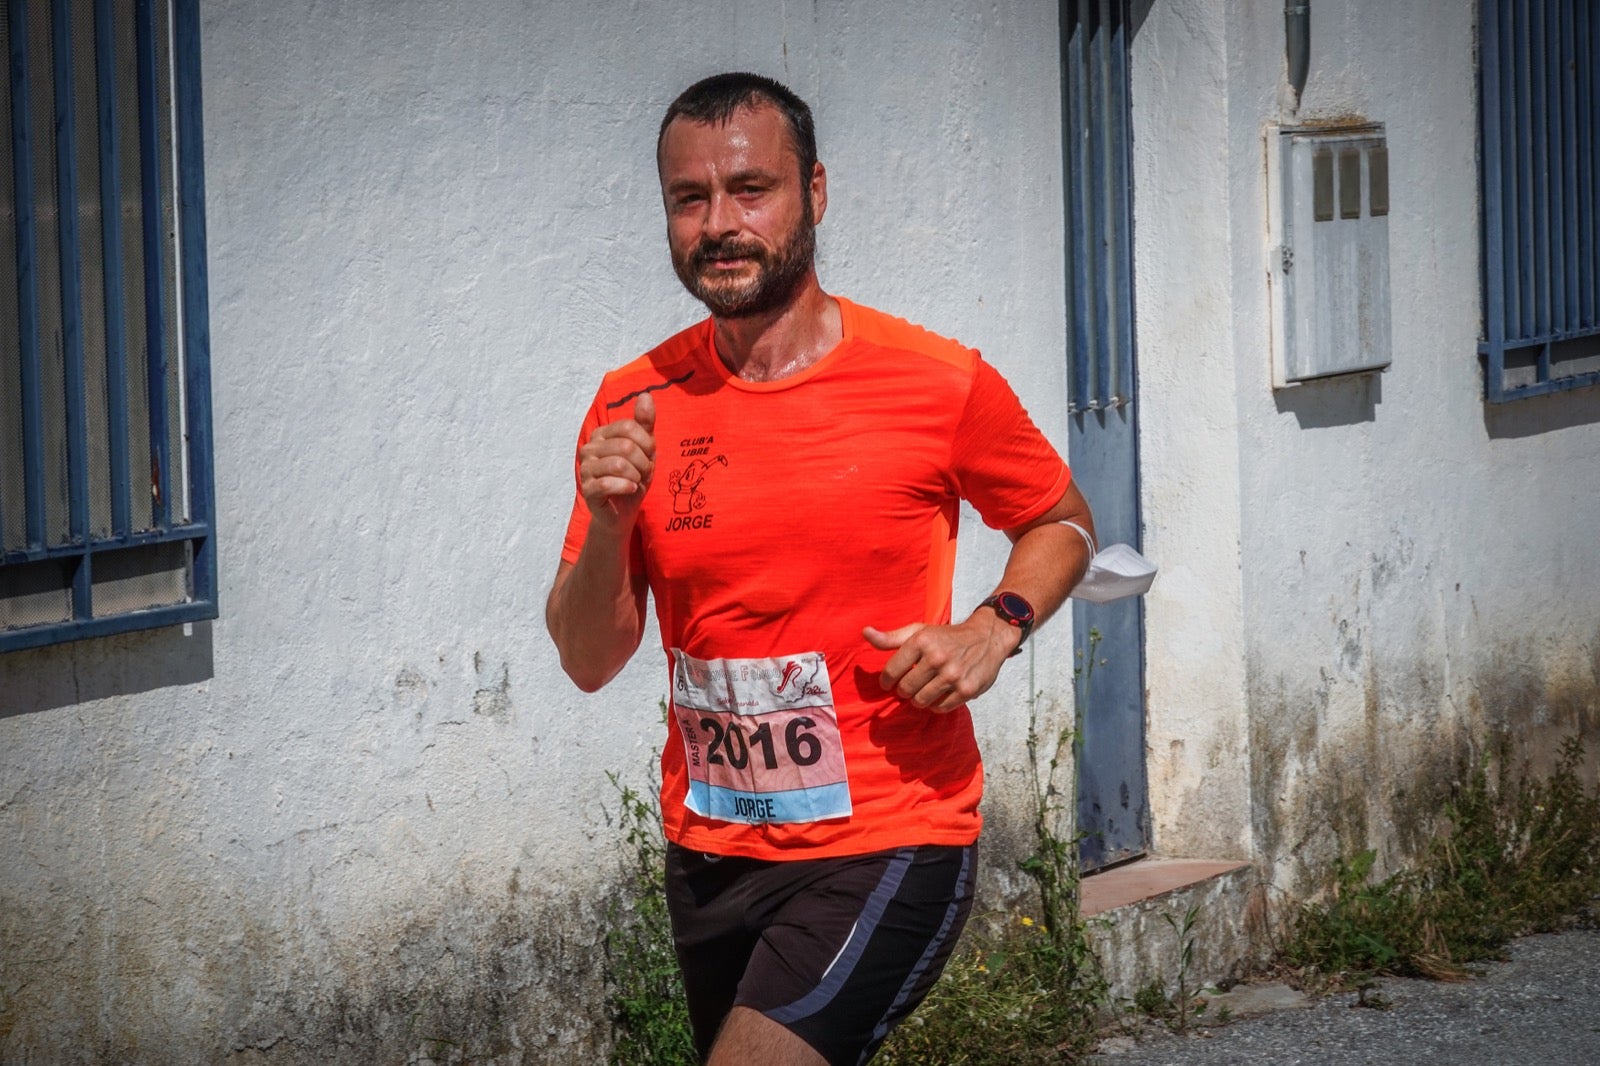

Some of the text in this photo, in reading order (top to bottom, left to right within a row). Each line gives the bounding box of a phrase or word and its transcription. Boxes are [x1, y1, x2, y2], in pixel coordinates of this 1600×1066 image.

[680, 436, 714, 447] CLUB'A
[681, 447, 710, 457] LIBRE
[665, 514, 714, 532] JORGE
[682, 719, 701, 767] MASTER A
[700, 716, 822, 770] 2016
[734, 796, 776, 818] JORGE
